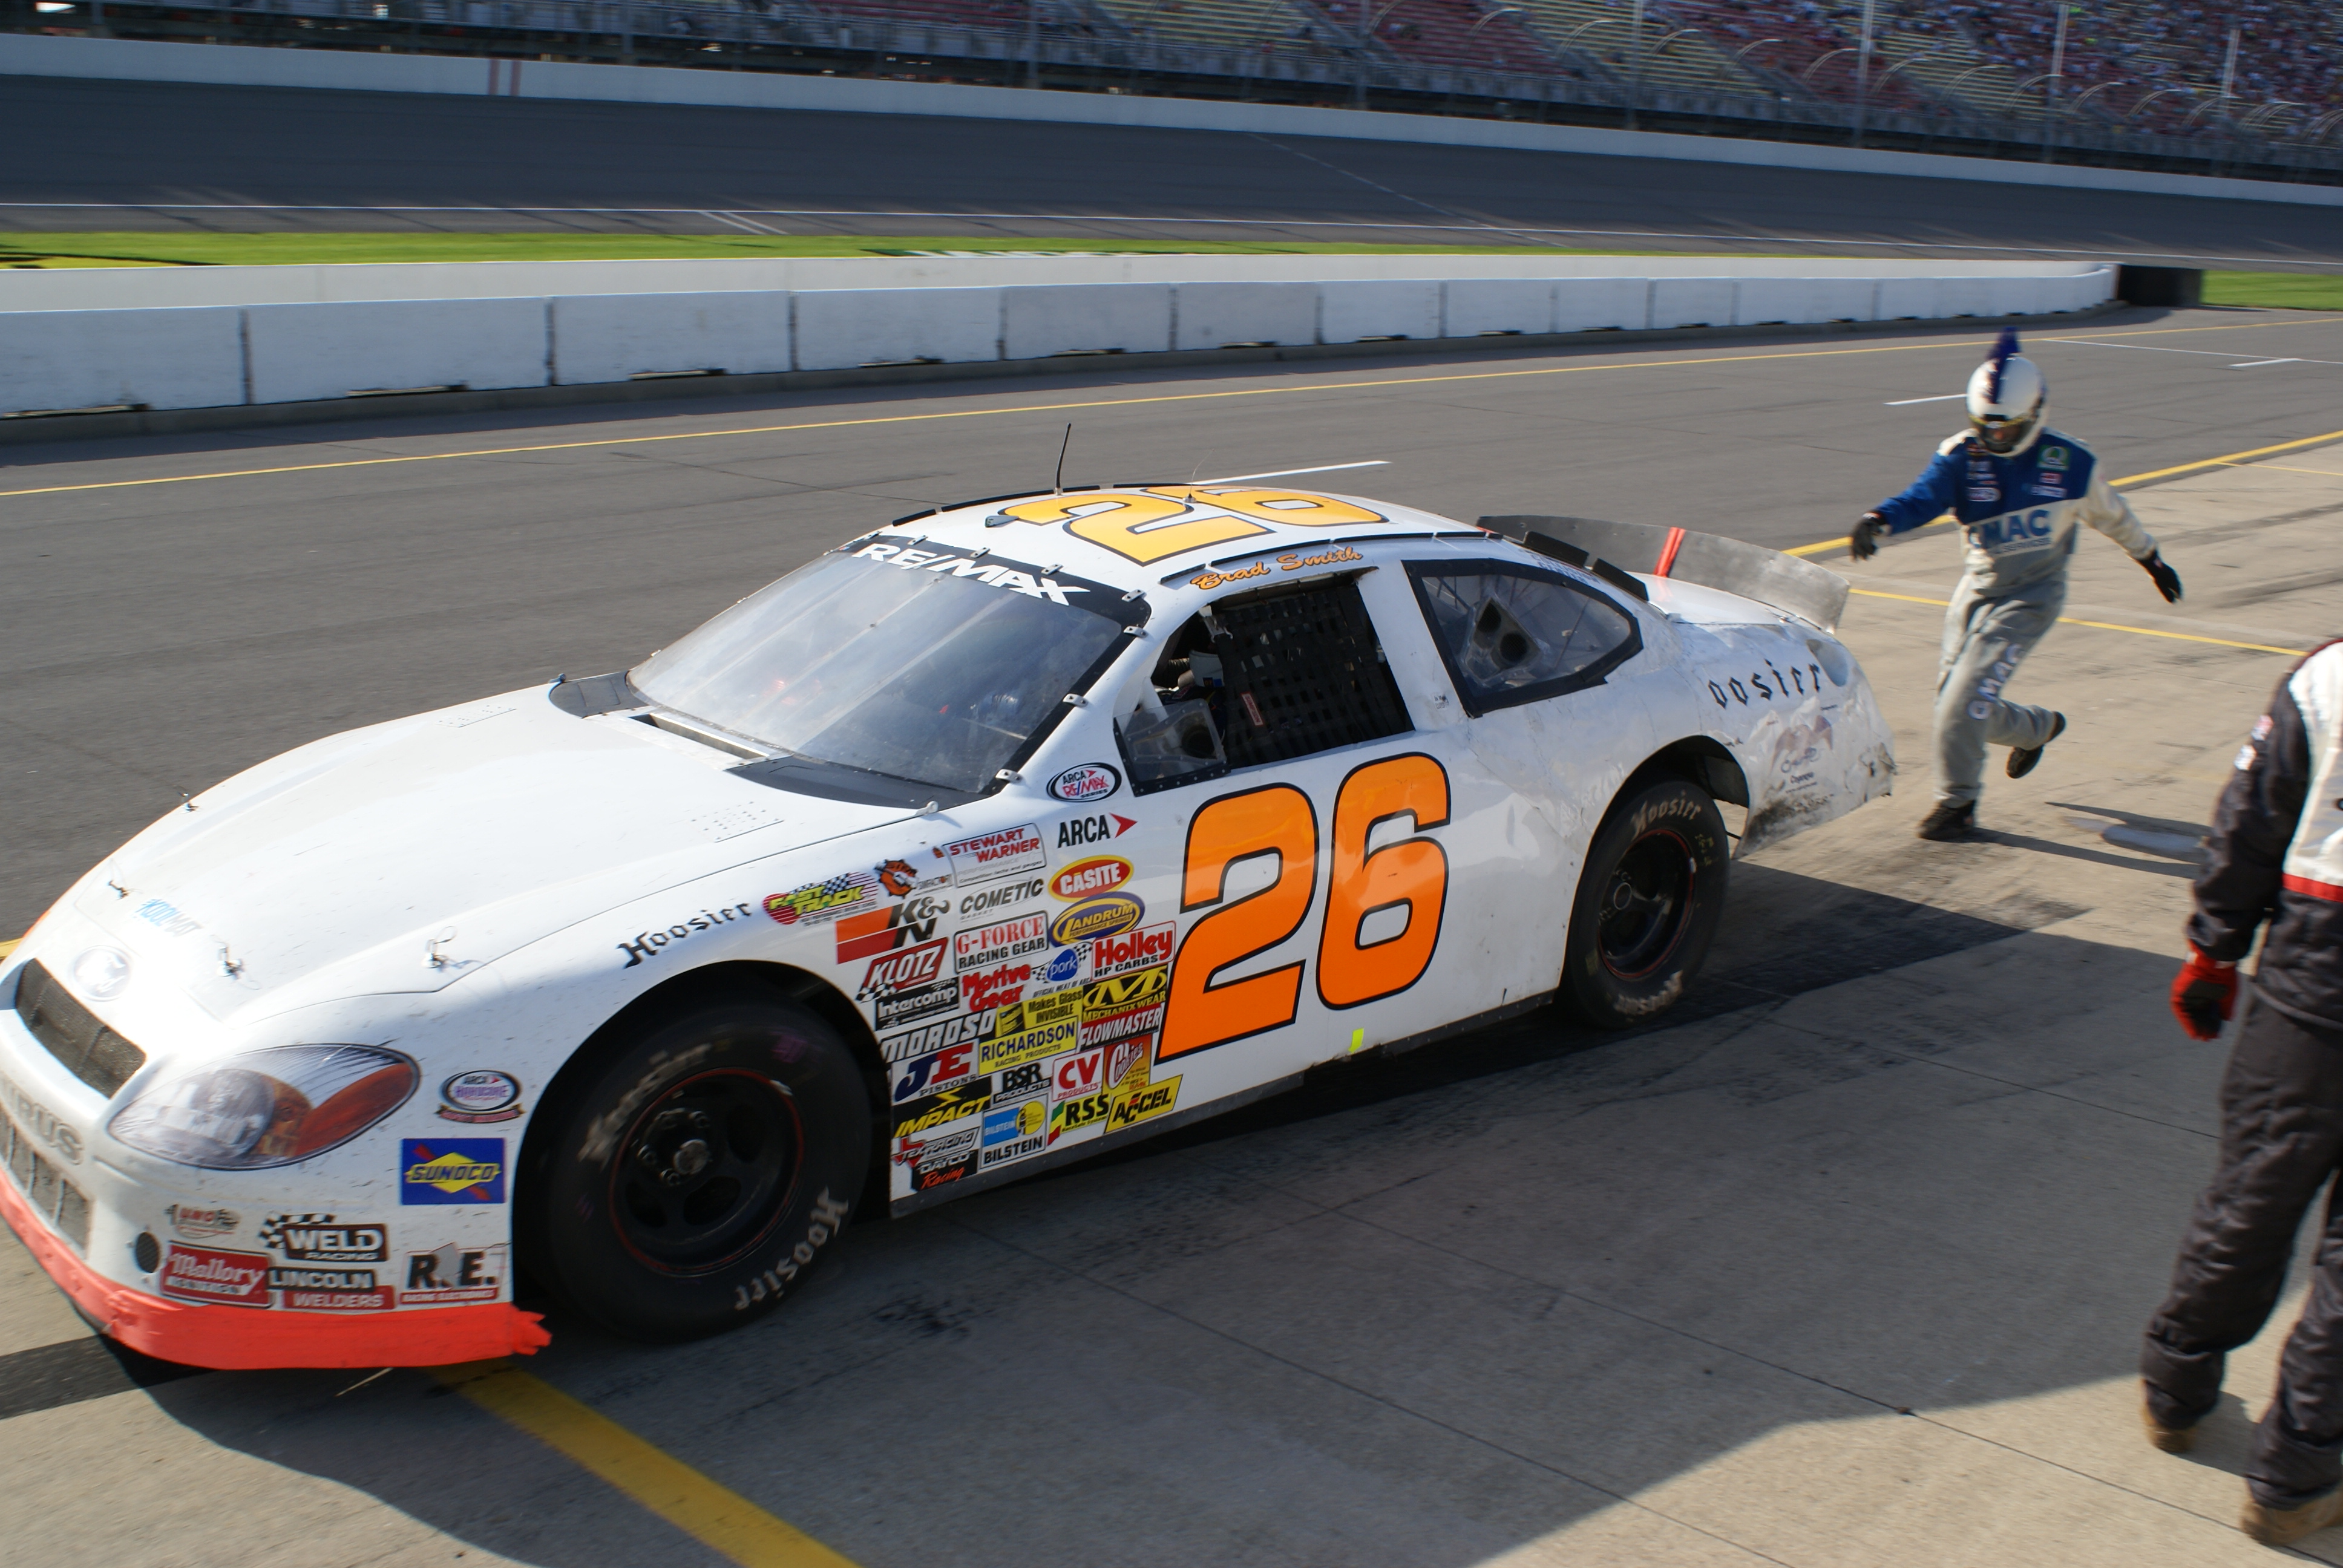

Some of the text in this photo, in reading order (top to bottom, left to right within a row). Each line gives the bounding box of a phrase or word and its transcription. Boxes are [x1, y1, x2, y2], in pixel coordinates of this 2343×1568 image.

[997, 485, 1389, 567] 26
[851, 543, 1090, 606] RE/MAX
[1190, 546, 1363, 589] Brad Smith
[1061, 775, 1109, 797] RE/MAX
[1063, 770, 1087, 785] ARCA
[1081, 789, 1108, 799] SERIES
[1631, 789, 1702, 841] Hoosier
[950, 828, 1024, 855] STEWART
[1058, 814, 1110, 848] ARCA
[975, 838, 1040, 863] WARNER
[768, 886, 825, 910] FAST
[793, 885, 865, 916] TRACK
[960, 878, 1044, 914] COMETIC
[1153, 751, 1451, 1066] 26
[960, 909, 993, 920] GASKET
[1061, 904, 1134, 942] LANDRUM
[1069, 914, 1132, 936] PERFORMANCE SPRINGS
[616, 903, 752, 969] Hoosier
[957, 916, 1044, 955] G-FORCE
[1095, 930, 1172, 969] Holley
[868, 944, 942, 988] KLOTZ
[959, 937, 1045, 969] RACING GEAR
[1049, 955, 1076, 979] pork
[1095, 955, 1159, 978] HP CARBS
[962, 964, 1031, 997] Motive
[878, 987, 957, 1018] Intercomp
[969, 984, 1024, 1013] Gear
[1028, 990, 1083, 1013] Makes Glass
[1036, 1004, 1074, 1024] INVISIBLE
[1083, 990, 1167, 1023] MECHANIX WEAR
[881, 1009, 997, 1063] MOROSO
[981, 1021, 1075, 1063] RICHARDSON
[1078, 1007, 1162, 1051] FLOWMASTER
[994, 1044, 1061, 1068] RACING PRODUCTS
[1058, 1053, 1101, 1089] CV
[894, 1042, 974, 1102] JE
[919, 1074, 977, 1097] PISTONS
[1003, 1062, 1043, 1093] BSR
[995, 1079, 1050, 1102] PRODUCTS
[1058, 1083, 1098, 1099] PRODUCTS
[1112, 1087, 1172, 1123] ACCEL
[893, 1095, 991, 1138] IMPACT
[1066, 1094, 1109, 1126] RSS
[985, 1120, 1015, 1136] BILSTEIN
[984, 1136, 1043, 1165] BILSTEIN
[411, 1165, 496, 1180] SUNOCO
[920, 1166, 965, 1190] Racing
[285, 1229, 385, 1251] WELD
[734, 1186, 848, 1310] Hoosier
[168, 1252, 266, 1286] Mallory
[304, 1252, 379, 1260] RACING
[269, 1269, 373, 1288] LINCOLN
[292, 1293, 384, 1307] WELDERS
